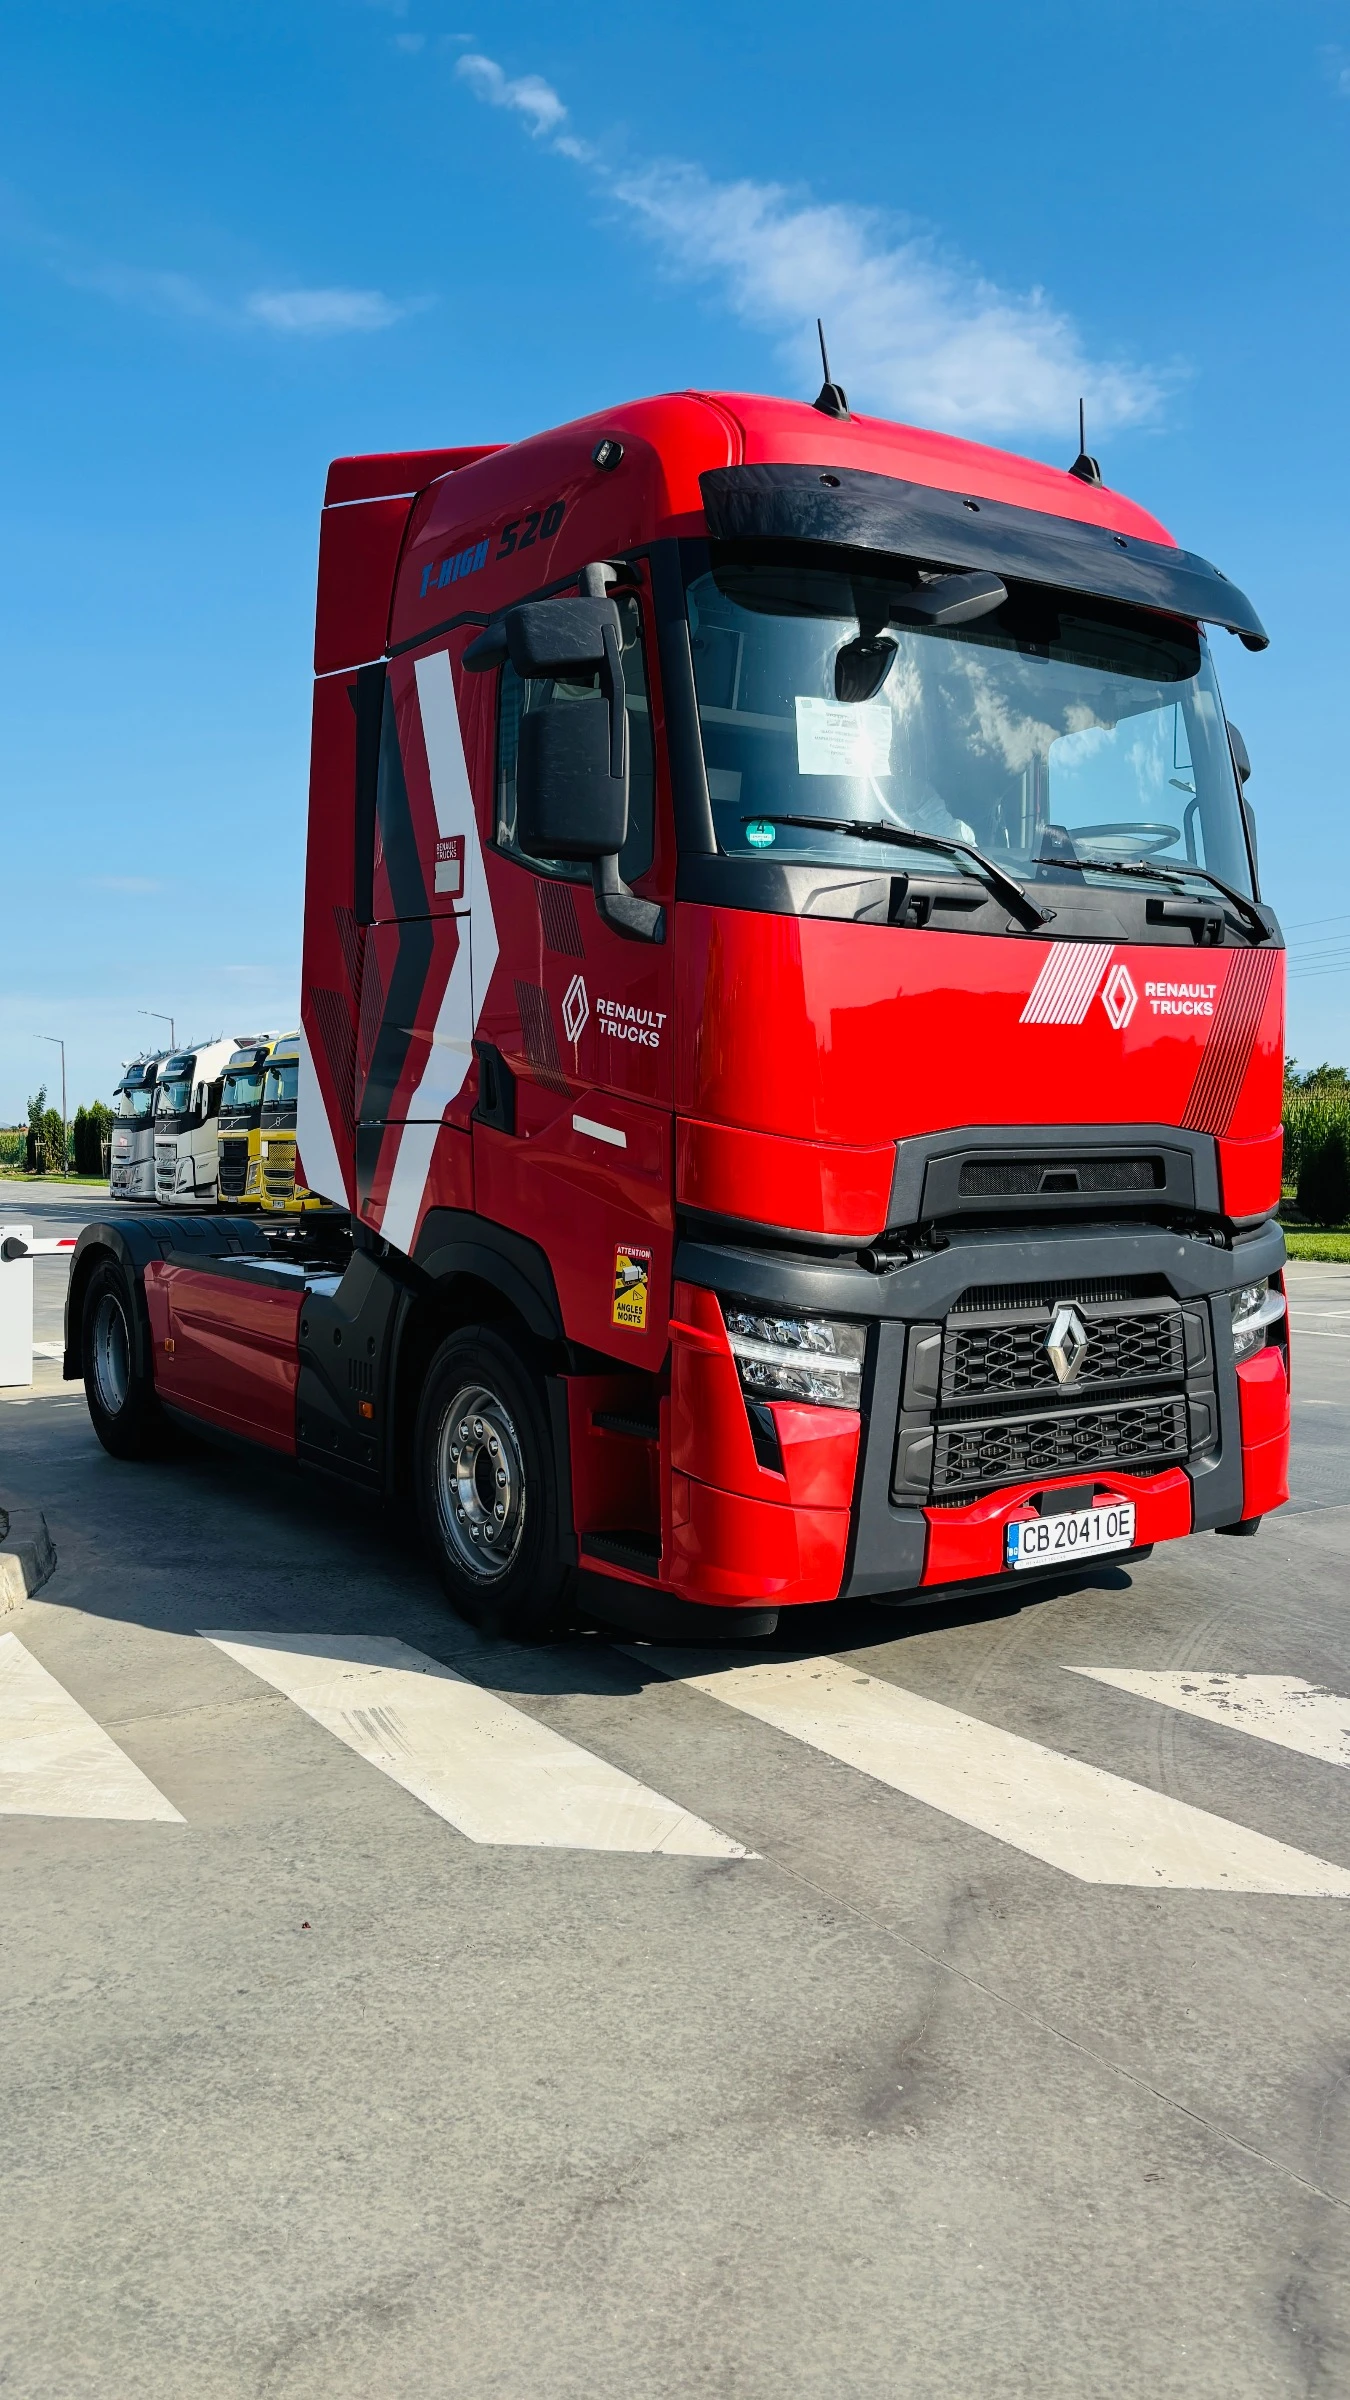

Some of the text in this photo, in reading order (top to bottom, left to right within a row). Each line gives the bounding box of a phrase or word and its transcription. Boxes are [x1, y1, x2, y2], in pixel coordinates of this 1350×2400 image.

[420, 499, 566, 598] T-HIGH 520
[436, 841, 457, 851] RENAULT
[436, 849, 457, 859] TRUCKS
[1145, 982, 1217, 999] RENAULT
[596, 998, 667, 1029] RENAULT
[1150, 1000, 1214, 1016] TRUCKS
[599, 1018, 660, 1048] TRUCKS
[616, 1246, 650, 1259] ATTENTION
[616, 1302, 643, 1315] ANGLES
[617, 1311, 641, 1324] MORTS
[1008, 1546, 1019, 1557] BG
